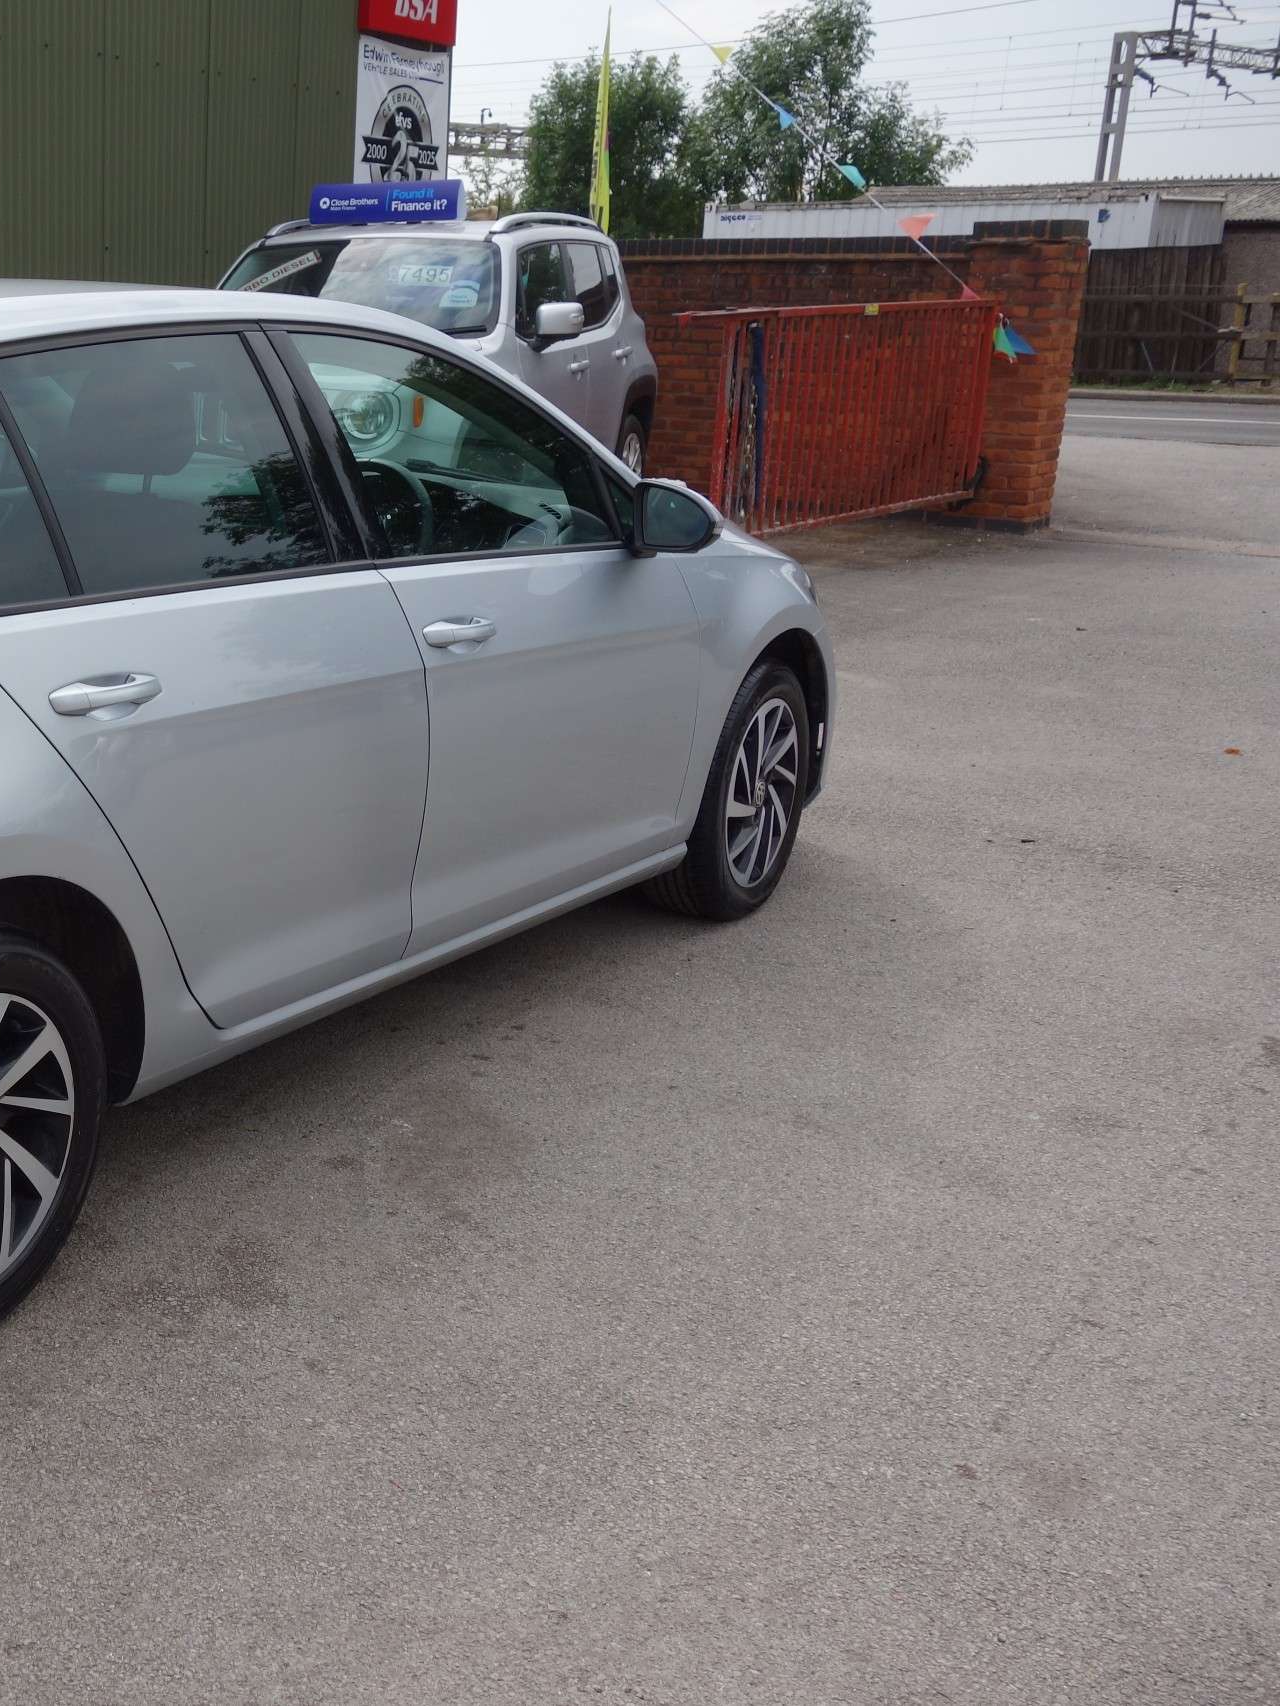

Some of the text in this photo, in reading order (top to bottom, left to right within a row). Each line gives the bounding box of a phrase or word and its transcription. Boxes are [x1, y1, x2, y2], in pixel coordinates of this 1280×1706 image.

[363, 44, 391, 64] Edwin
[366, 143, 387, 160] 2000
[418, 150, 436, 165] 2025
[392, 187, 434, 200] Found it
[330, 198, 379, 207] Close Brothers
[391, 198, 448, 212] Finance it?
[272, 256, 315, 278] DIESEL
[400, 267, 450, 283] 7495
